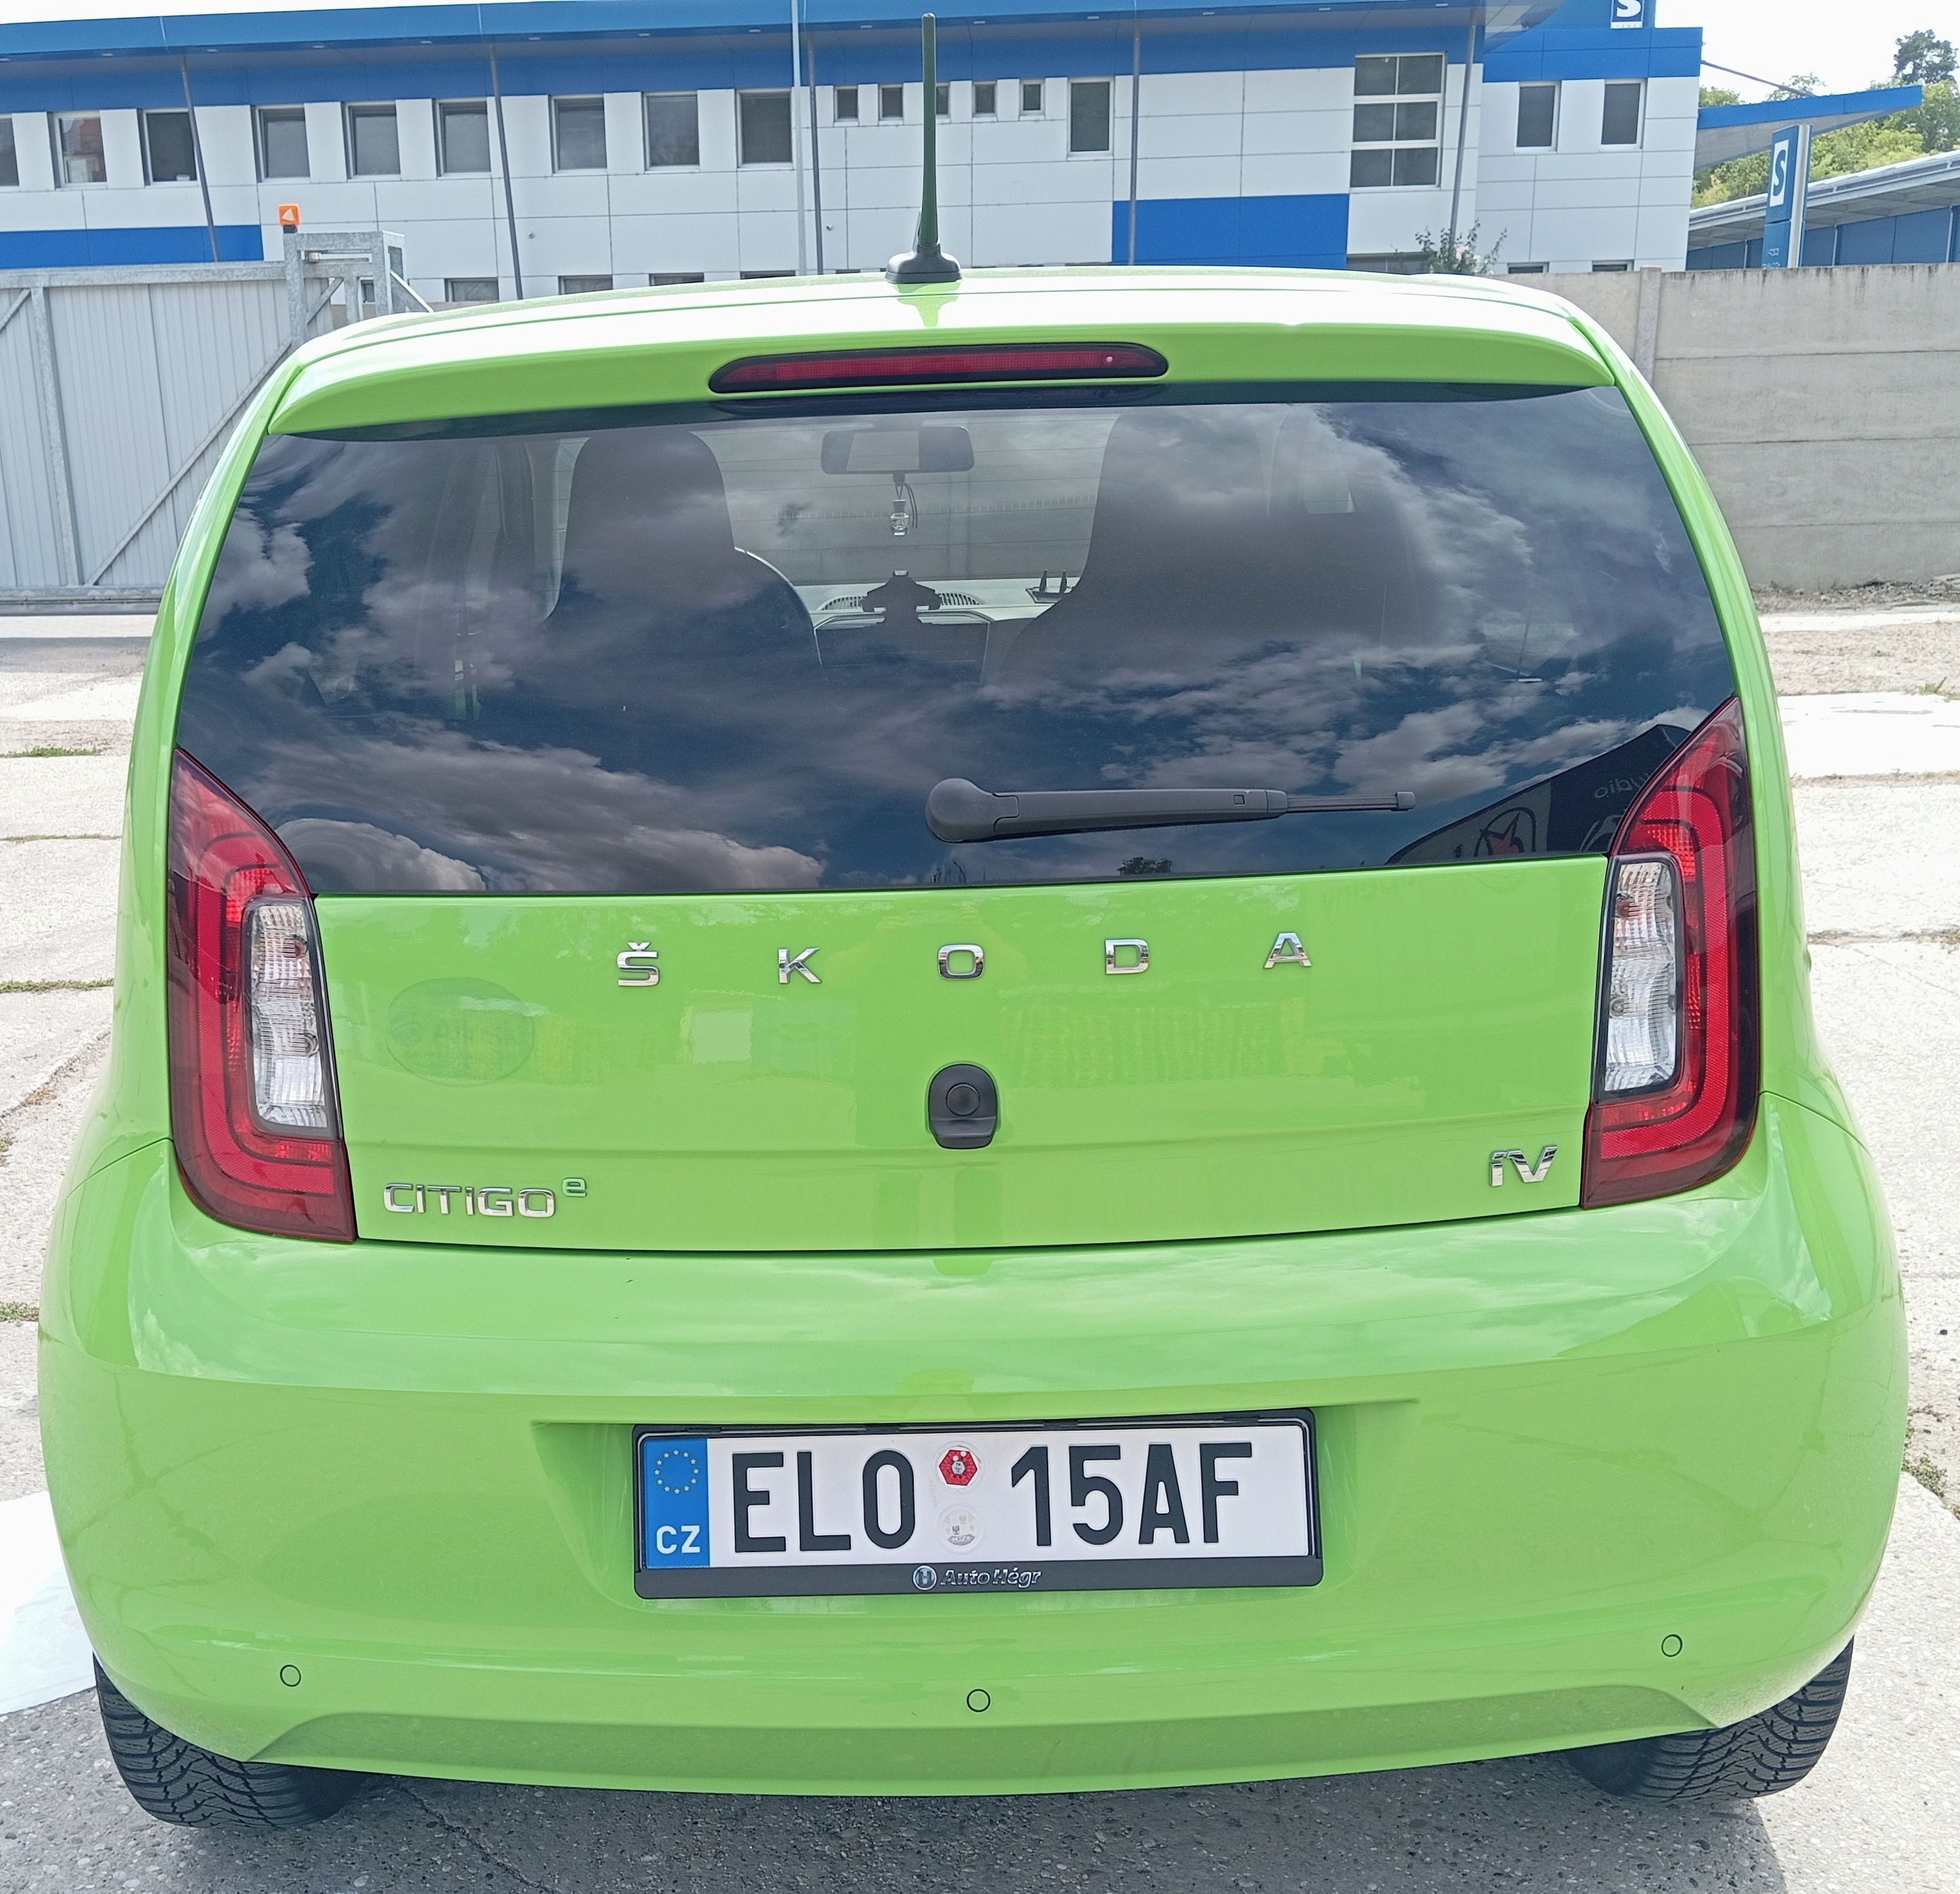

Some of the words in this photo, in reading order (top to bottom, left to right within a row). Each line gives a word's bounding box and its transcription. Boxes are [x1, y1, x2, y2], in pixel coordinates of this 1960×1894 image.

[616, 932, 1312, 987] ŠKODA
[1011, 1443, 1252, 1546] 15AF
[656, 1525, 701, 1554] CZ
